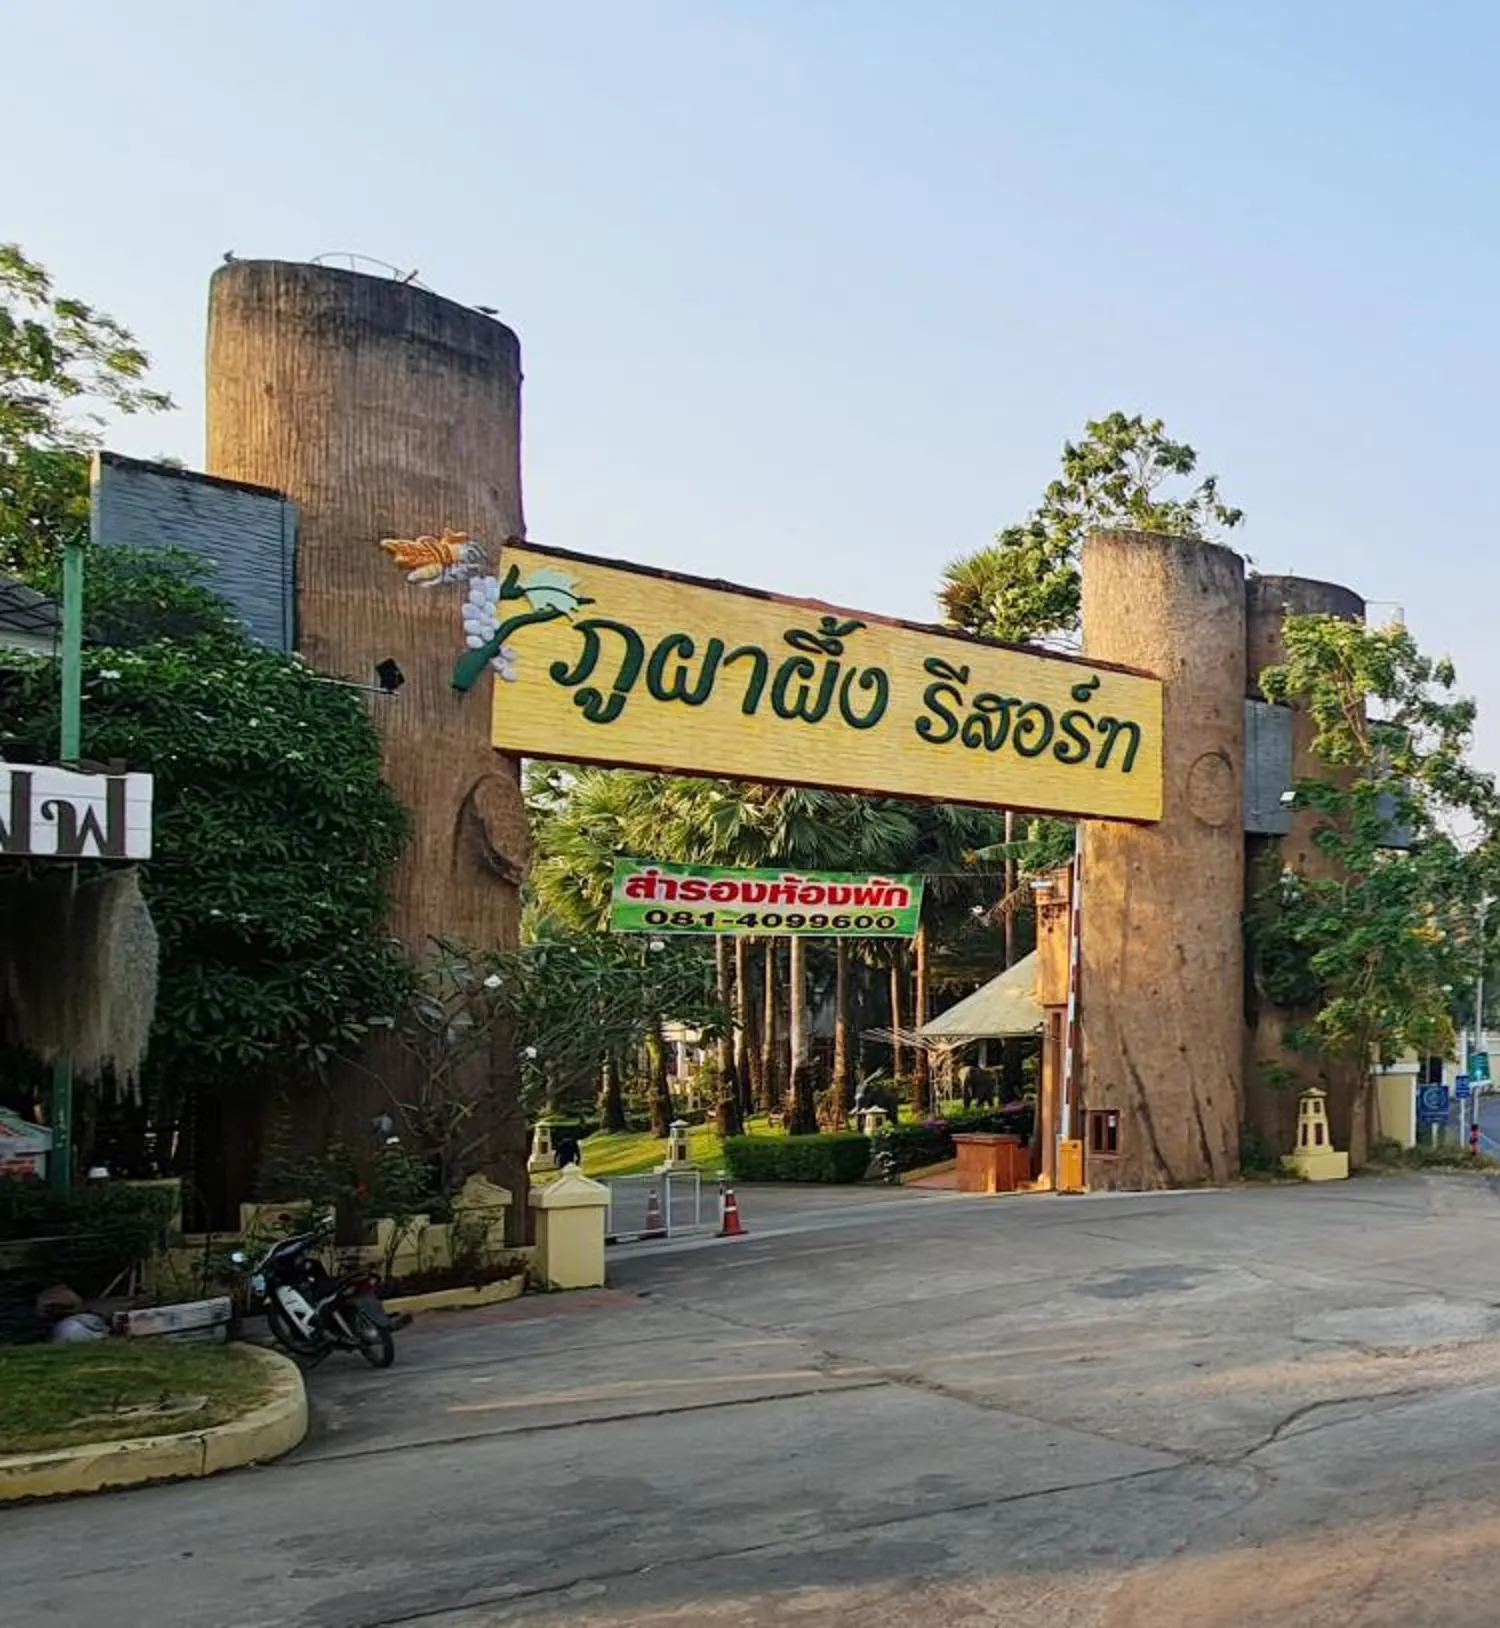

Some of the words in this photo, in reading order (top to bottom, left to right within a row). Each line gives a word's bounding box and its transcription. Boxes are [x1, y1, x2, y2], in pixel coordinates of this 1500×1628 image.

[549, 616, 890, 729] ภูผาผึ้ง
[915, 656, 1141, 773] รีสอร์ท
[624, 869, 910, 907] สำรองห้องพัก
[644, 909, 896, 929] 081-4099600
